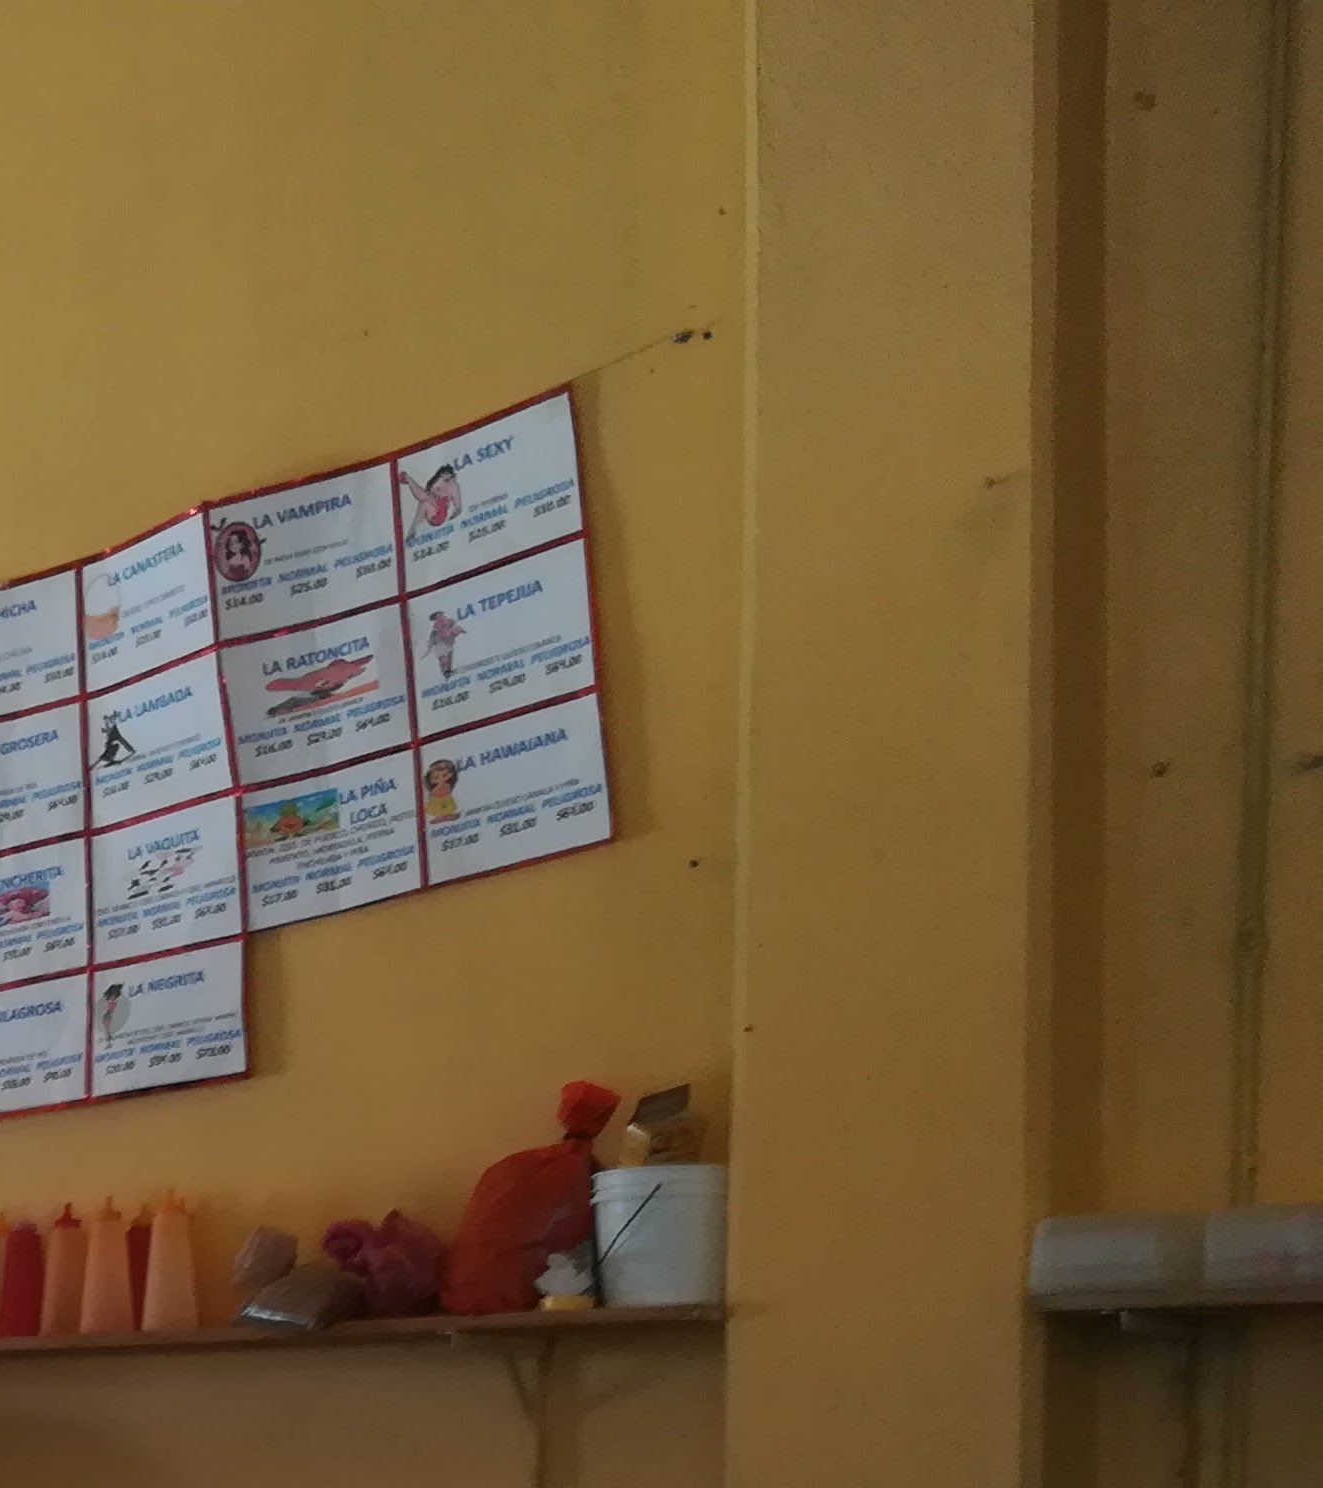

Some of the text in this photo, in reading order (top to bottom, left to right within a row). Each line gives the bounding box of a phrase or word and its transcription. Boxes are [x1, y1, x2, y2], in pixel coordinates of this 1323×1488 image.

[454, 435, 514, 471] LA SEXY
[253, 494, 353, 530] LA VAMPIRA
[107, 571, 121, 587] LA
[456, 604, 476, 621] LA
[262, 636, 370, 676] LA RATONCITA
[119, 686, 194, 723] LA LAMBADA
[0, 730, 59, 755] GROSERA
[456, 728, 569, 773] LA HAWAIANA
[340, 777, 397, 805] LA PIÑA
[350, 802, 388, 825] LOCA
[127, 828, 200, 860] LA VAQUITA
[128, 970, 205, 998] LA NEGRITA
